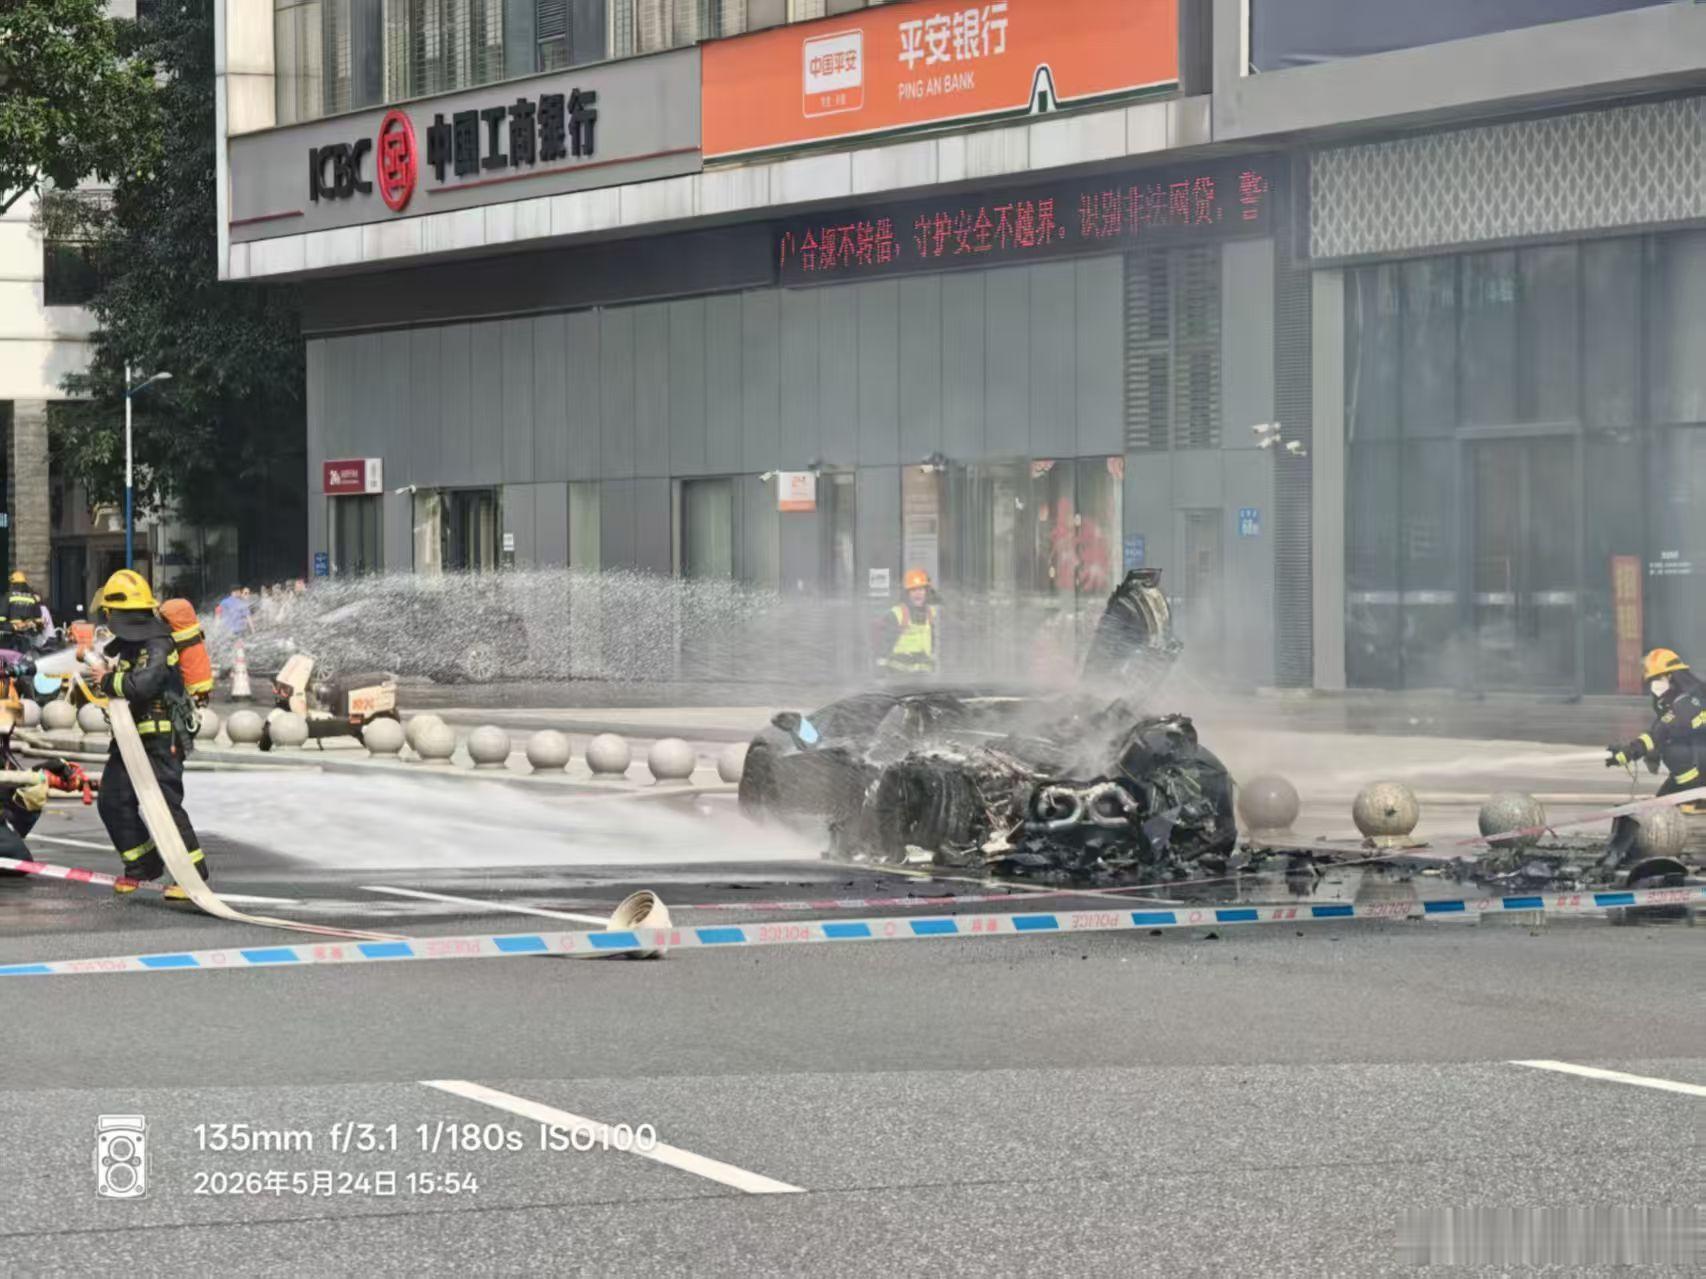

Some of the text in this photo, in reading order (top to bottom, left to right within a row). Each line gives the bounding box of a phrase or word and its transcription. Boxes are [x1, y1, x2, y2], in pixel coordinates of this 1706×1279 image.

[898, 3, 1009, 70] 平安银行
[809, 49, 857, 78] 中国平安
[898, 72, 976, 101] PING AN BANK
[309, 88, 597, 202] ICBC 中国工商银行
[760, 926, 810, 940] POLICE
[1072, 914, 1119, 928] POLICE
